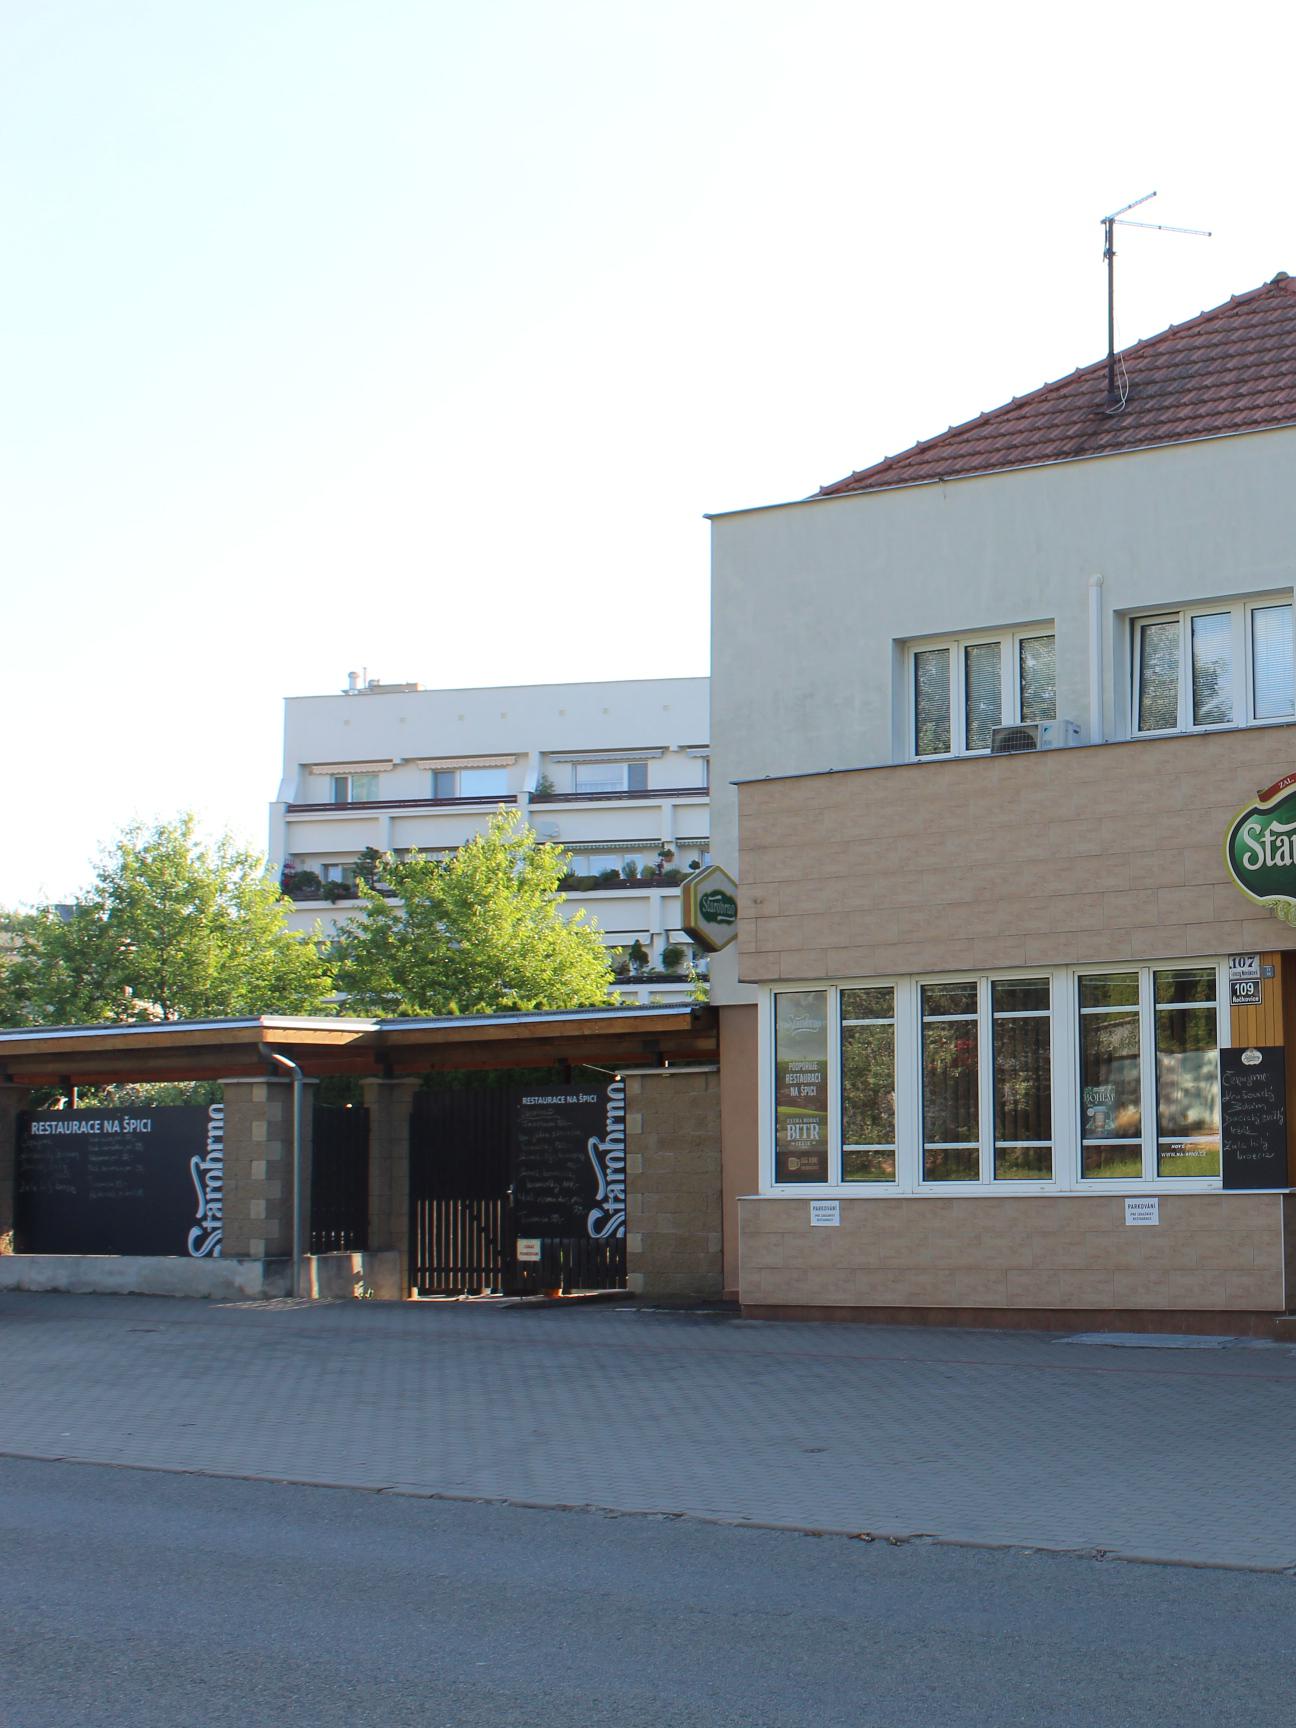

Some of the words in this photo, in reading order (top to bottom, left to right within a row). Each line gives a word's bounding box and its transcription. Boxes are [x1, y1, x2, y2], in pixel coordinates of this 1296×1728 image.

[1278, 778, 1294, 789] ZAL.
[1232, 956, 1255, 968] 107
[1235, 983, 1254, 995] 109
[522, 1096, 565, 1105] RESTAURACE
[567, 1095, 577, 1103] NA
[579, 1093, 597, 1103] ŠPICI
[31, 1120, 100, 1135] RESTAURACE
[104, 1119, 120, 1133] NA
[124, 1116, 152, 1132] ŠPICI
[787, 1124, 820, 1141] BITR
